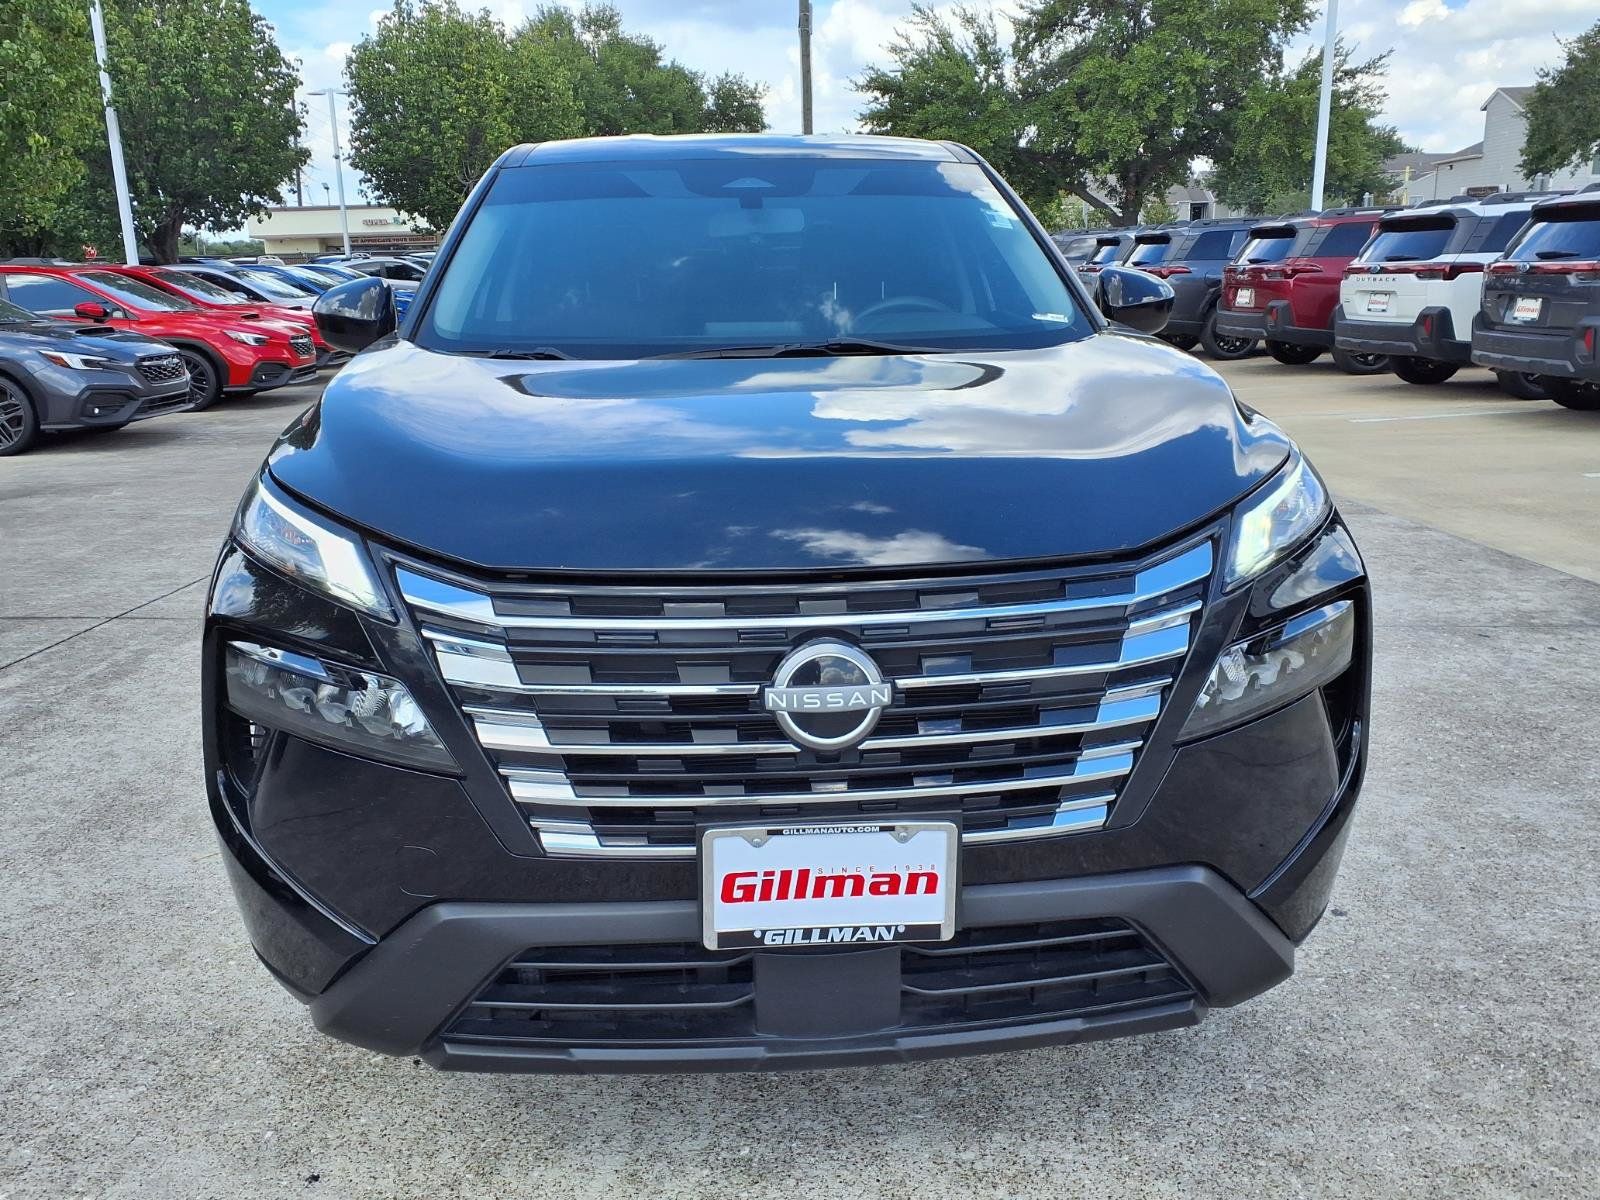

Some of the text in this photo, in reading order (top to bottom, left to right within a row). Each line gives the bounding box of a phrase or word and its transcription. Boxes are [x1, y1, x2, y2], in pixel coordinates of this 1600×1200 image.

[768, 688, 889, 708] NISSAN
[782, 826, 880, 835] GILLMANAUTO.COM
[817, 864, 936, 874] SINCE 1938
[720, 868, 939, 903] Gillman
[763, 925, 896, 945] GILLMAN
